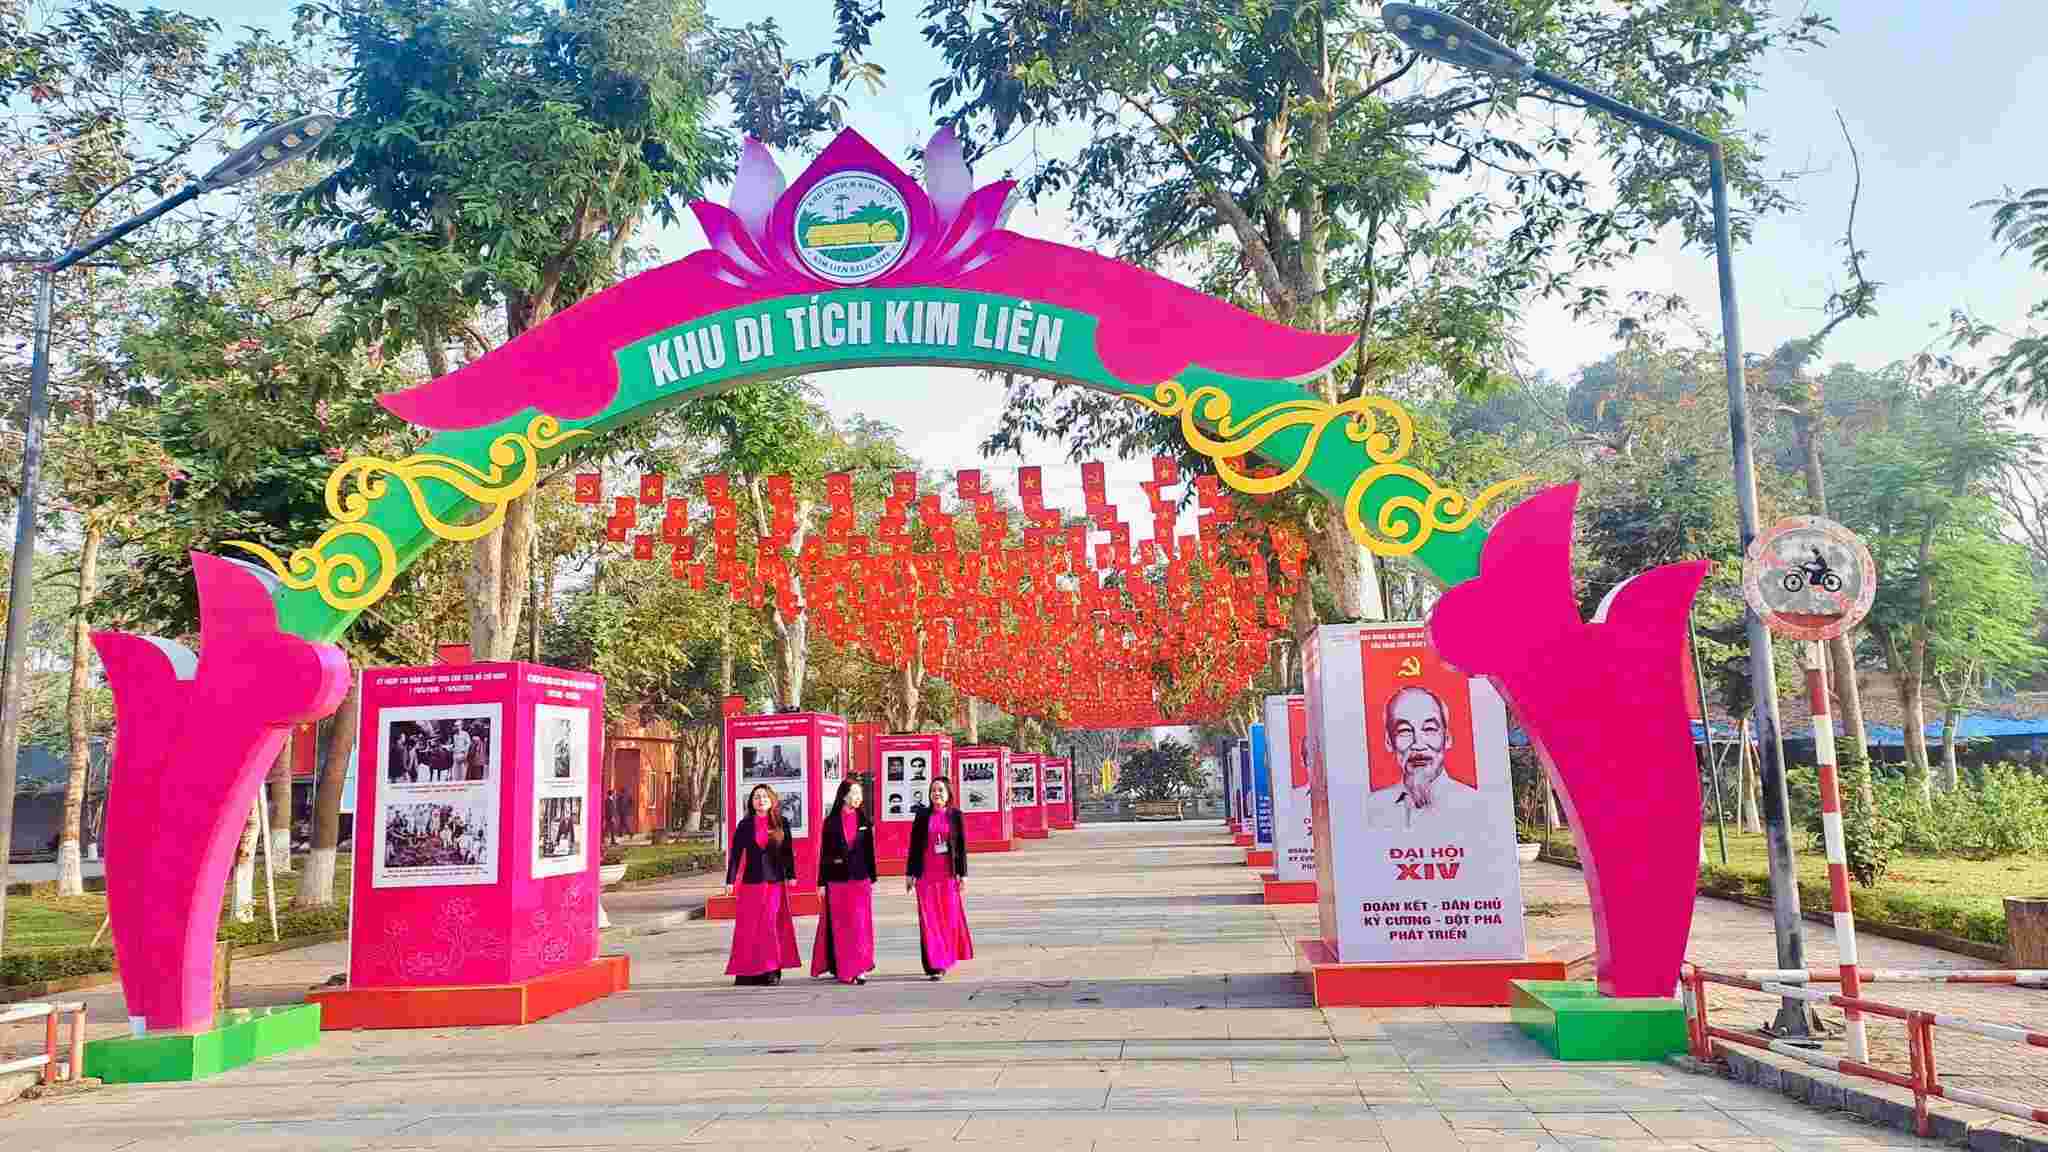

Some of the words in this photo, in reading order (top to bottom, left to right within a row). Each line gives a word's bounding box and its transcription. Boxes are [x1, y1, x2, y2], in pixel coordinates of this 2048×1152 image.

[648, 324, 726, 387] KHU
[734, 313, 775, 363] DI
[785, 295, 872, 351] TÍCH
[885, 300, 960, 346] KIM
[974, 299, 1064, 361] LIÊN
[1389, 847, 1424, 862] ĐẠI
[1431, 844, 1464, 862] HỘI
[1396, 863, 1460, 880] XIV
[1363, 901, 1400, 912] ĐOÀN
[1403, 900, 1428, 911] KẾT
[1441, 900, 1470, 911] DÂN
[1474, 897, 1502, 910] CHỦ
